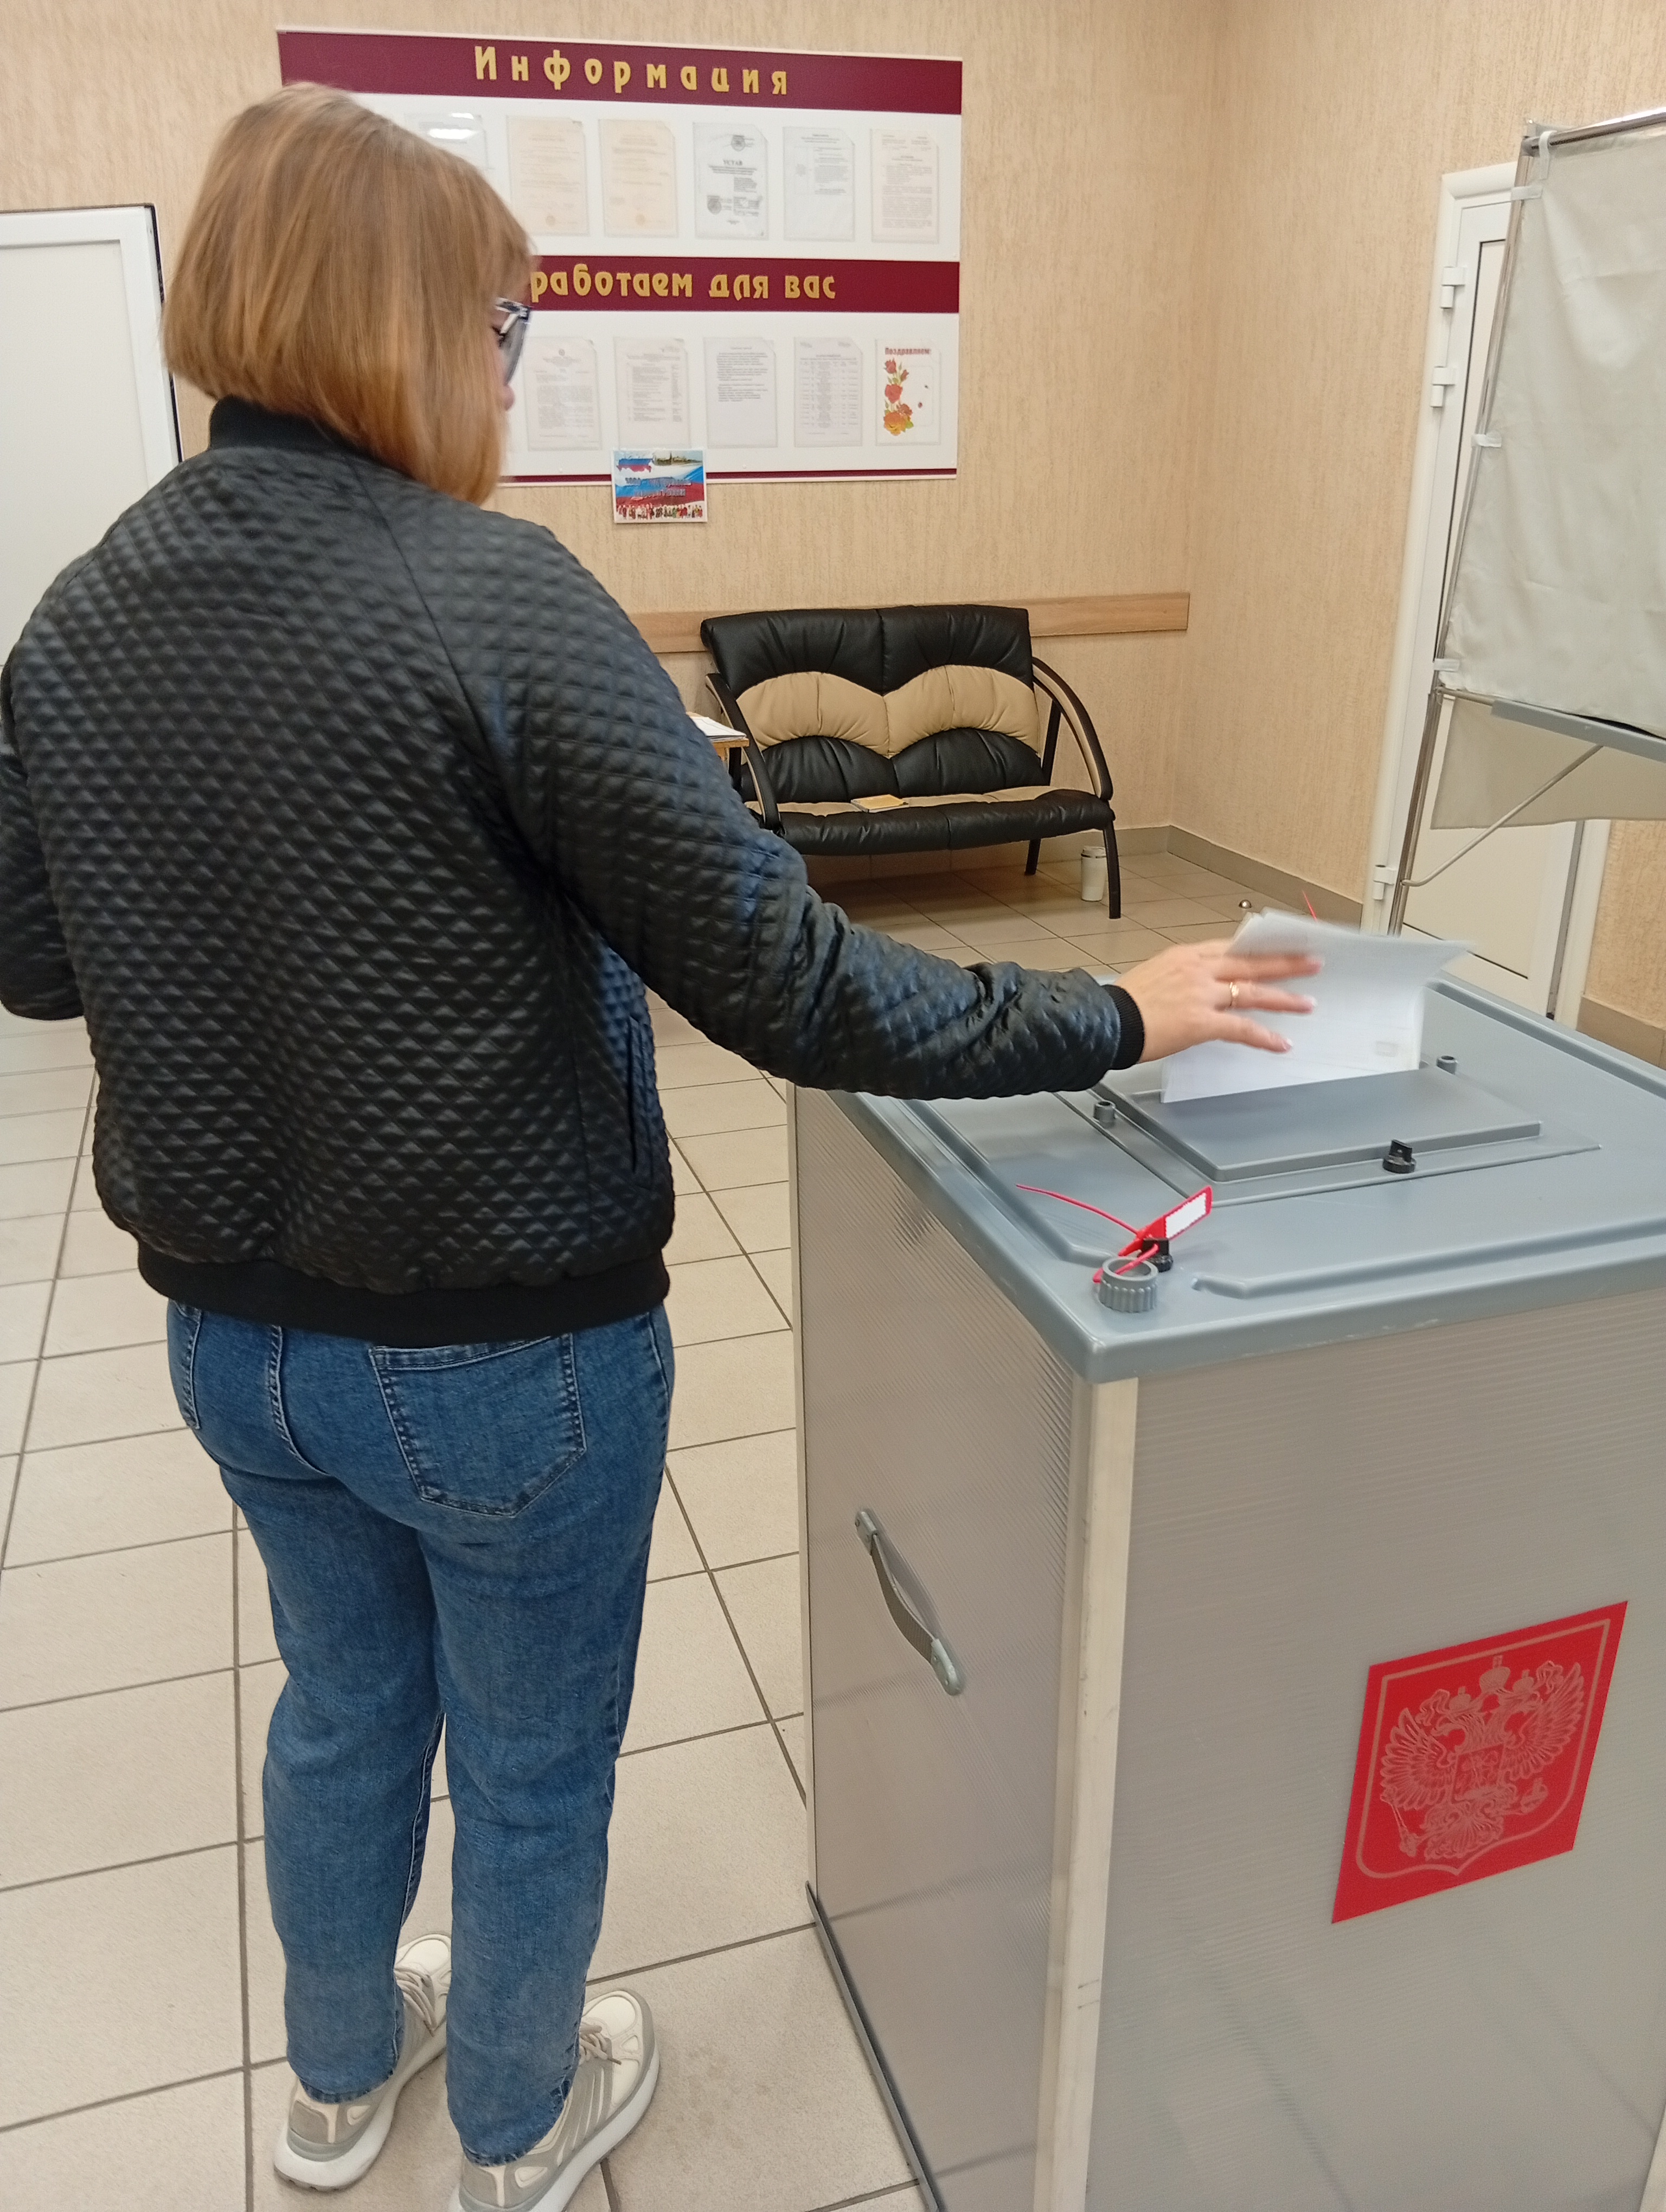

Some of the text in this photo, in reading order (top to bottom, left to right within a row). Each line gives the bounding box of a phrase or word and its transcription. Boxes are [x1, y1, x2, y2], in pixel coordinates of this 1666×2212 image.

[475, 46, 787, 95] Информация
[530, 263, 836, 303] работаем для вас
